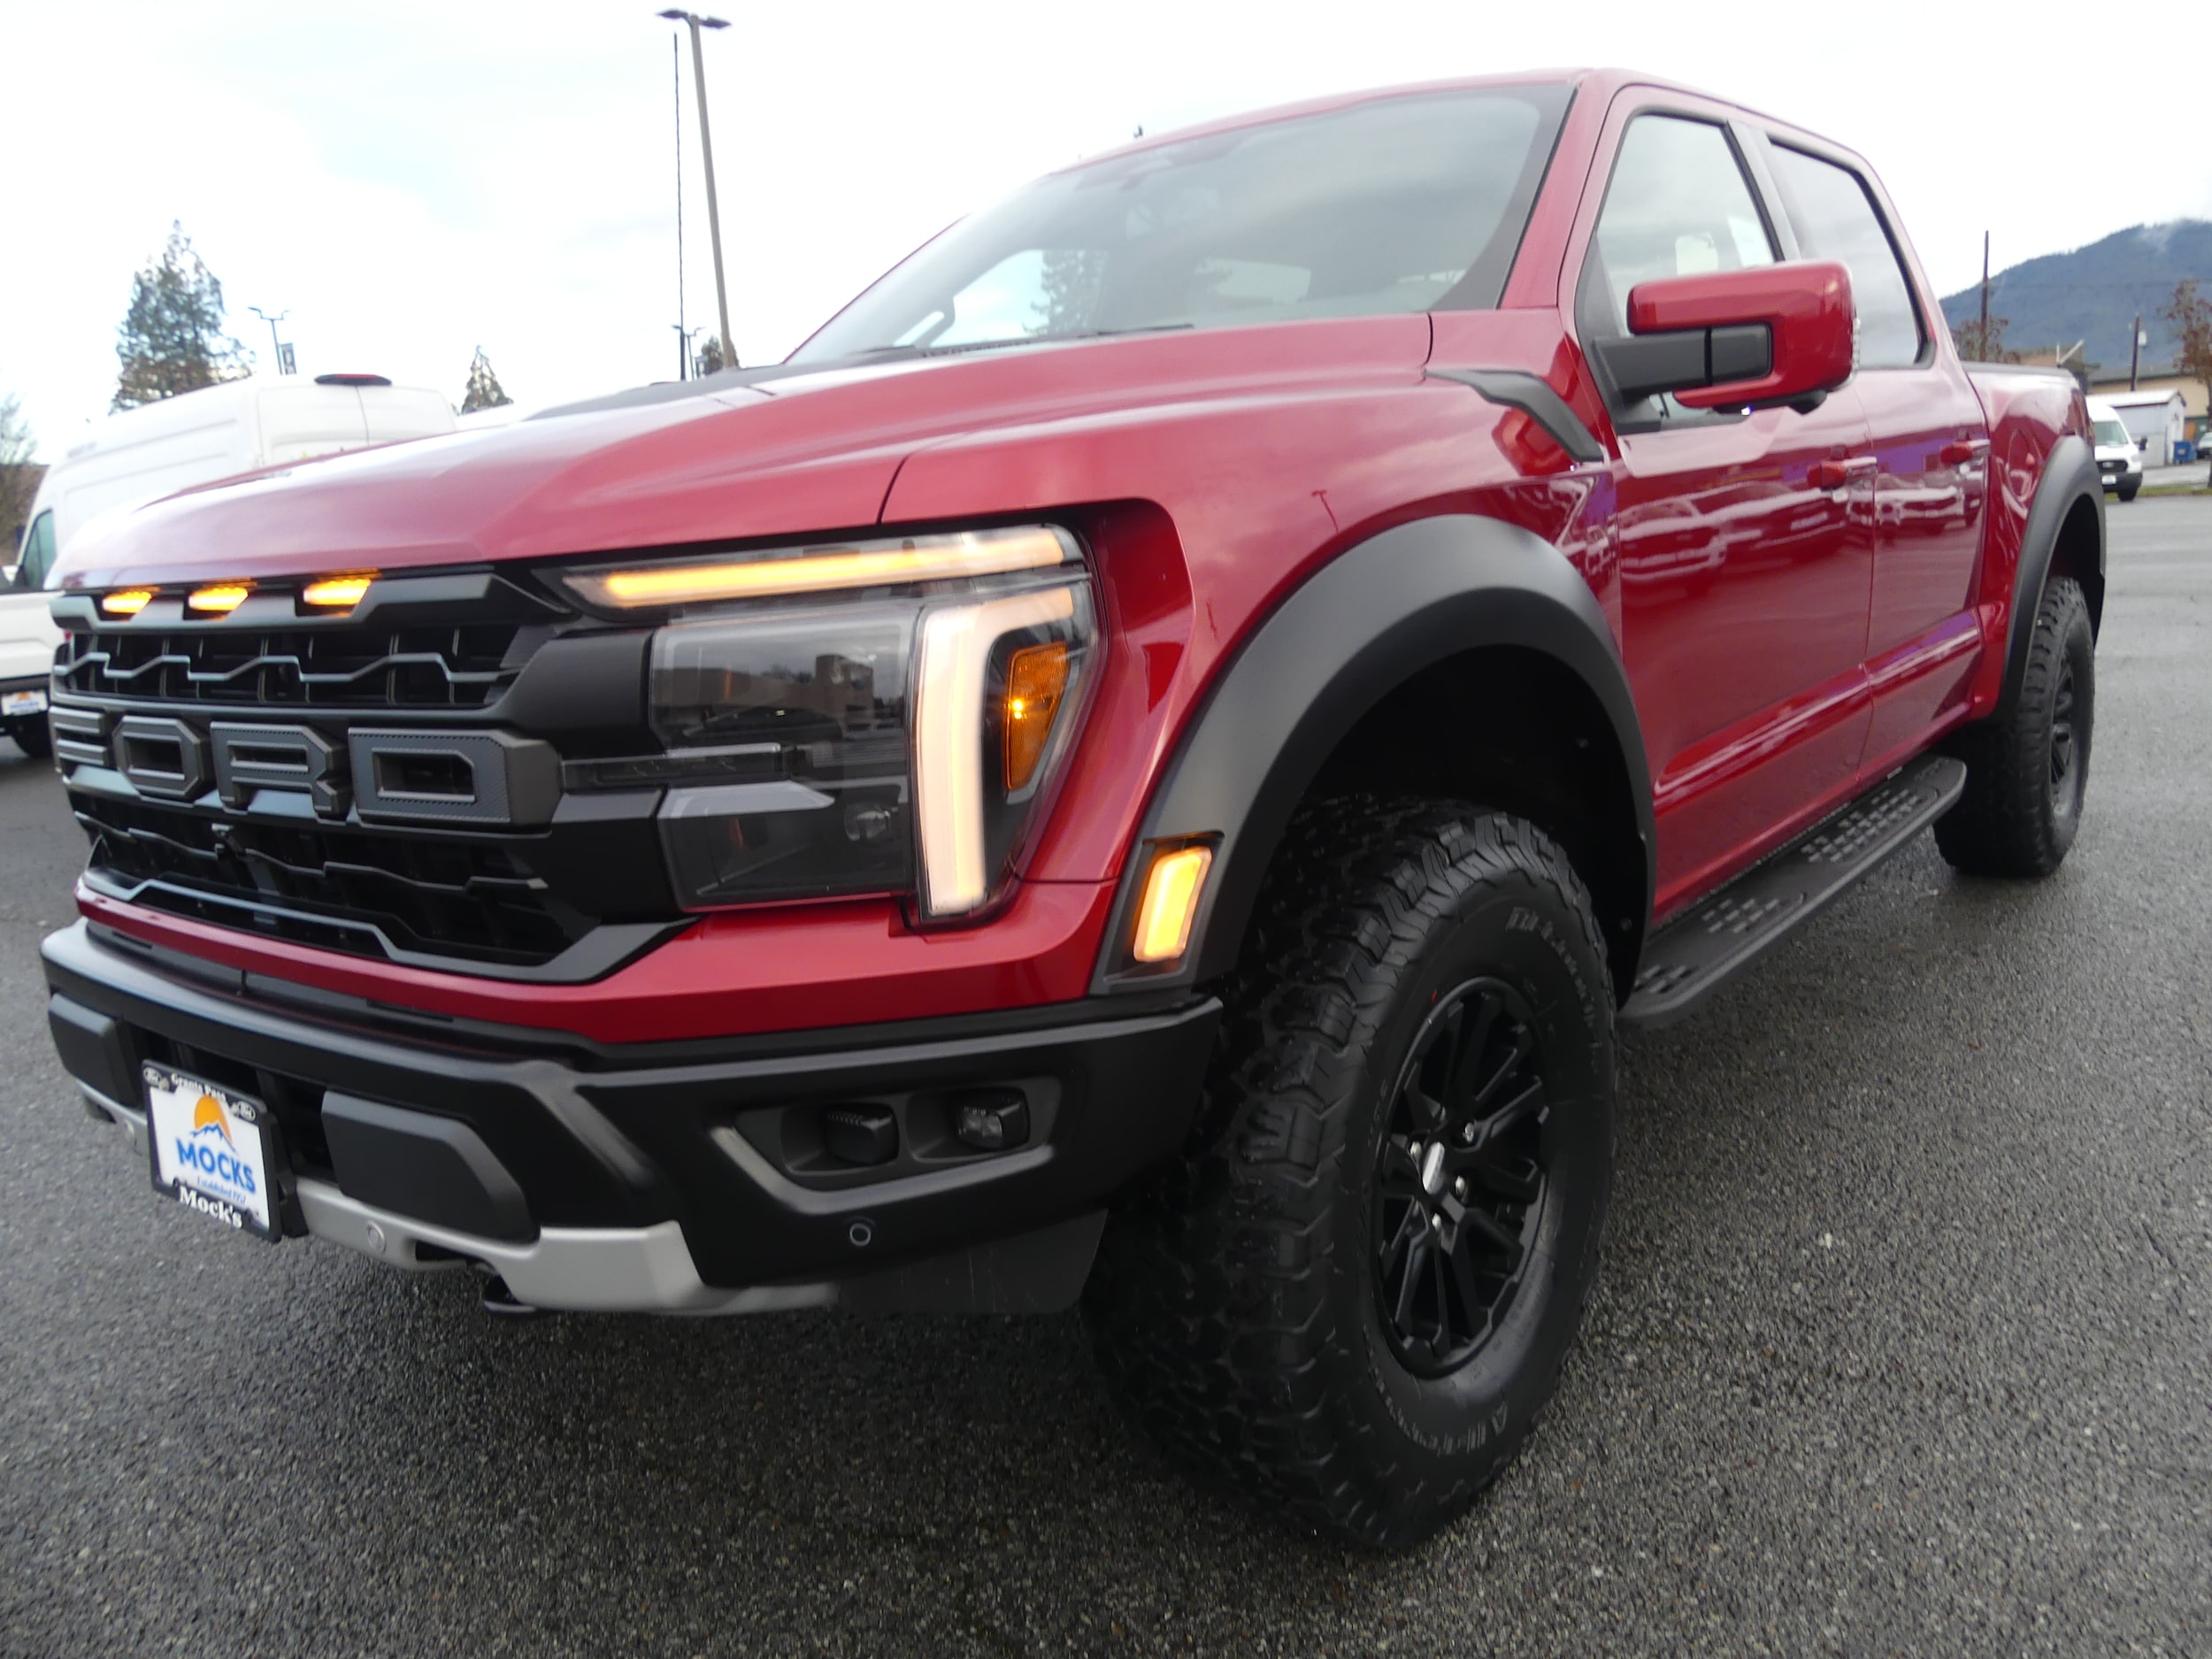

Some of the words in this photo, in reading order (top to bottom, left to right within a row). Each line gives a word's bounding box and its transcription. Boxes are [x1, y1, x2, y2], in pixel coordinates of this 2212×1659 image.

[50, 706, 561, 833] FORD
[176, 1137, 256, 1194] MOCKS
[180, 1186, 242, 1229] Mock's
